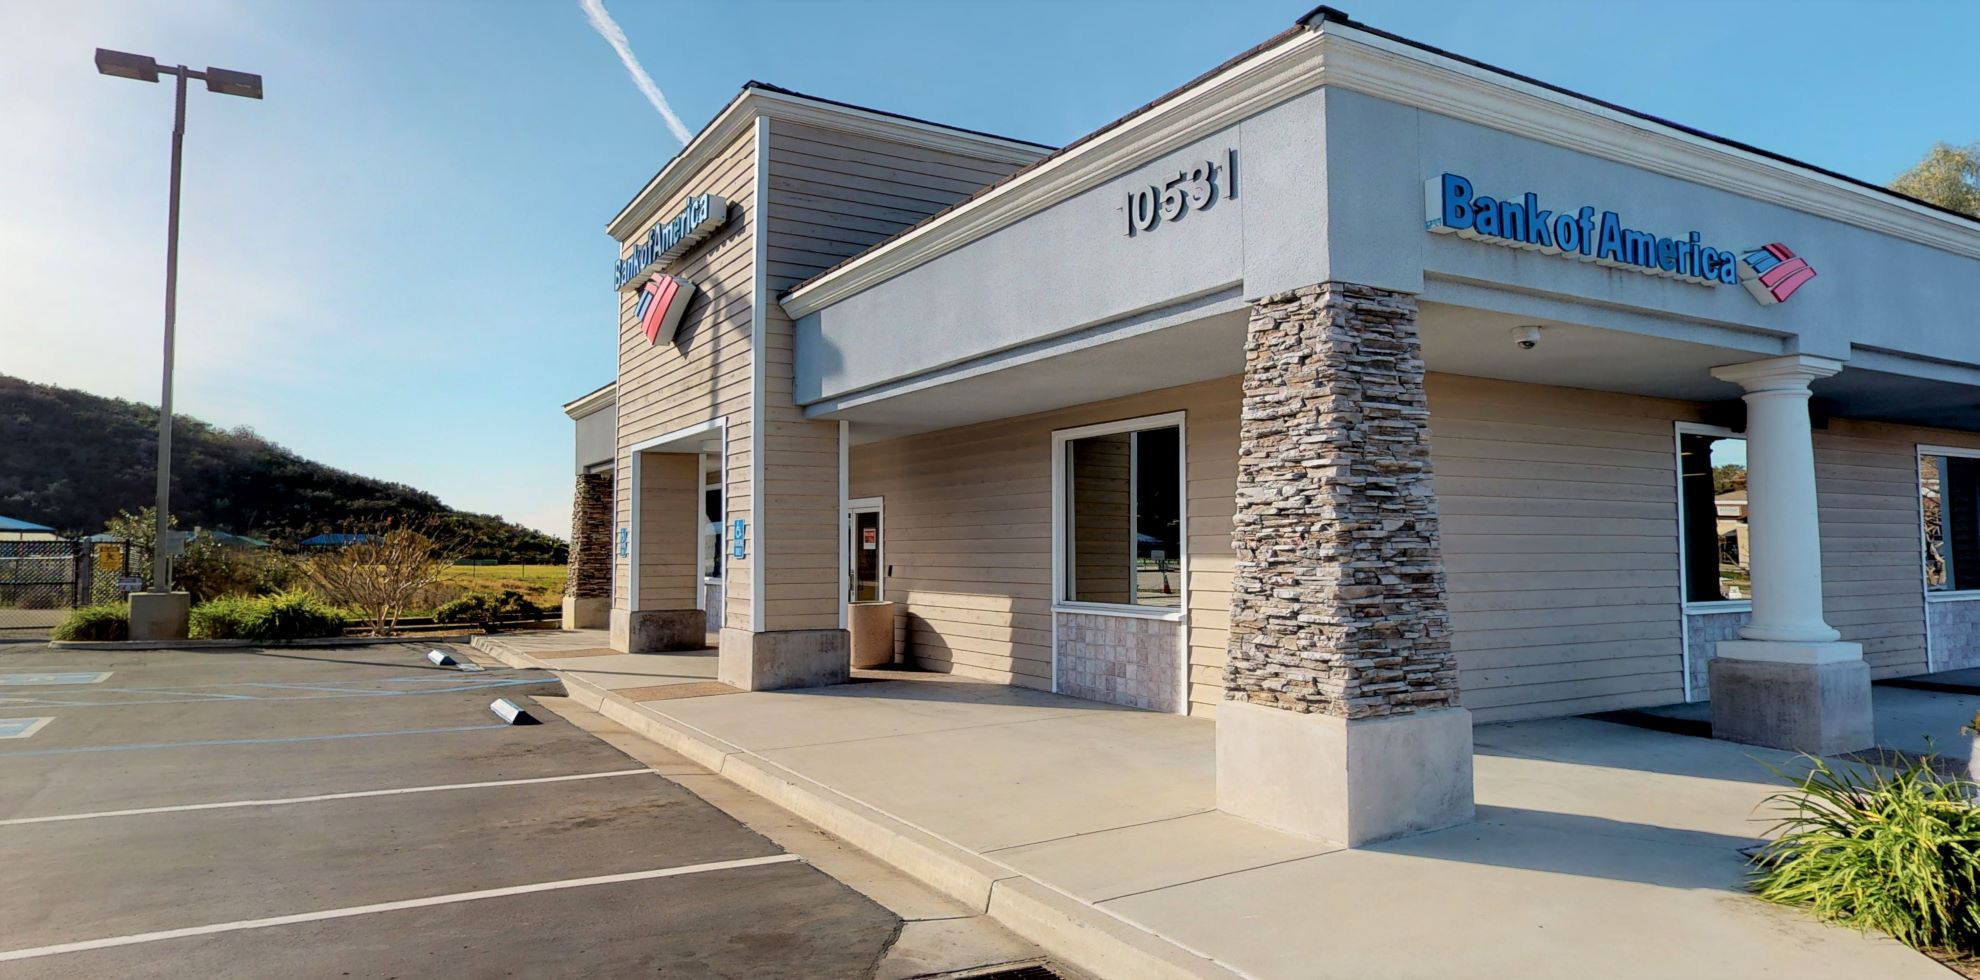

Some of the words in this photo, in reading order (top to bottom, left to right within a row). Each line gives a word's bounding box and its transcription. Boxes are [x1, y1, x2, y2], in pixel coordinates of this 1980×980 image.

[1122, 147, 1236, 237] 10531
[1442, 173, 1553, 246] Bank
[1554, 206, 1595, 256] of
[1596, 211, 1738, 285] America
[613, 243, 642, 291] Bank
[641, 229, 655, 268] of
[652, 193, 710, 258] America
